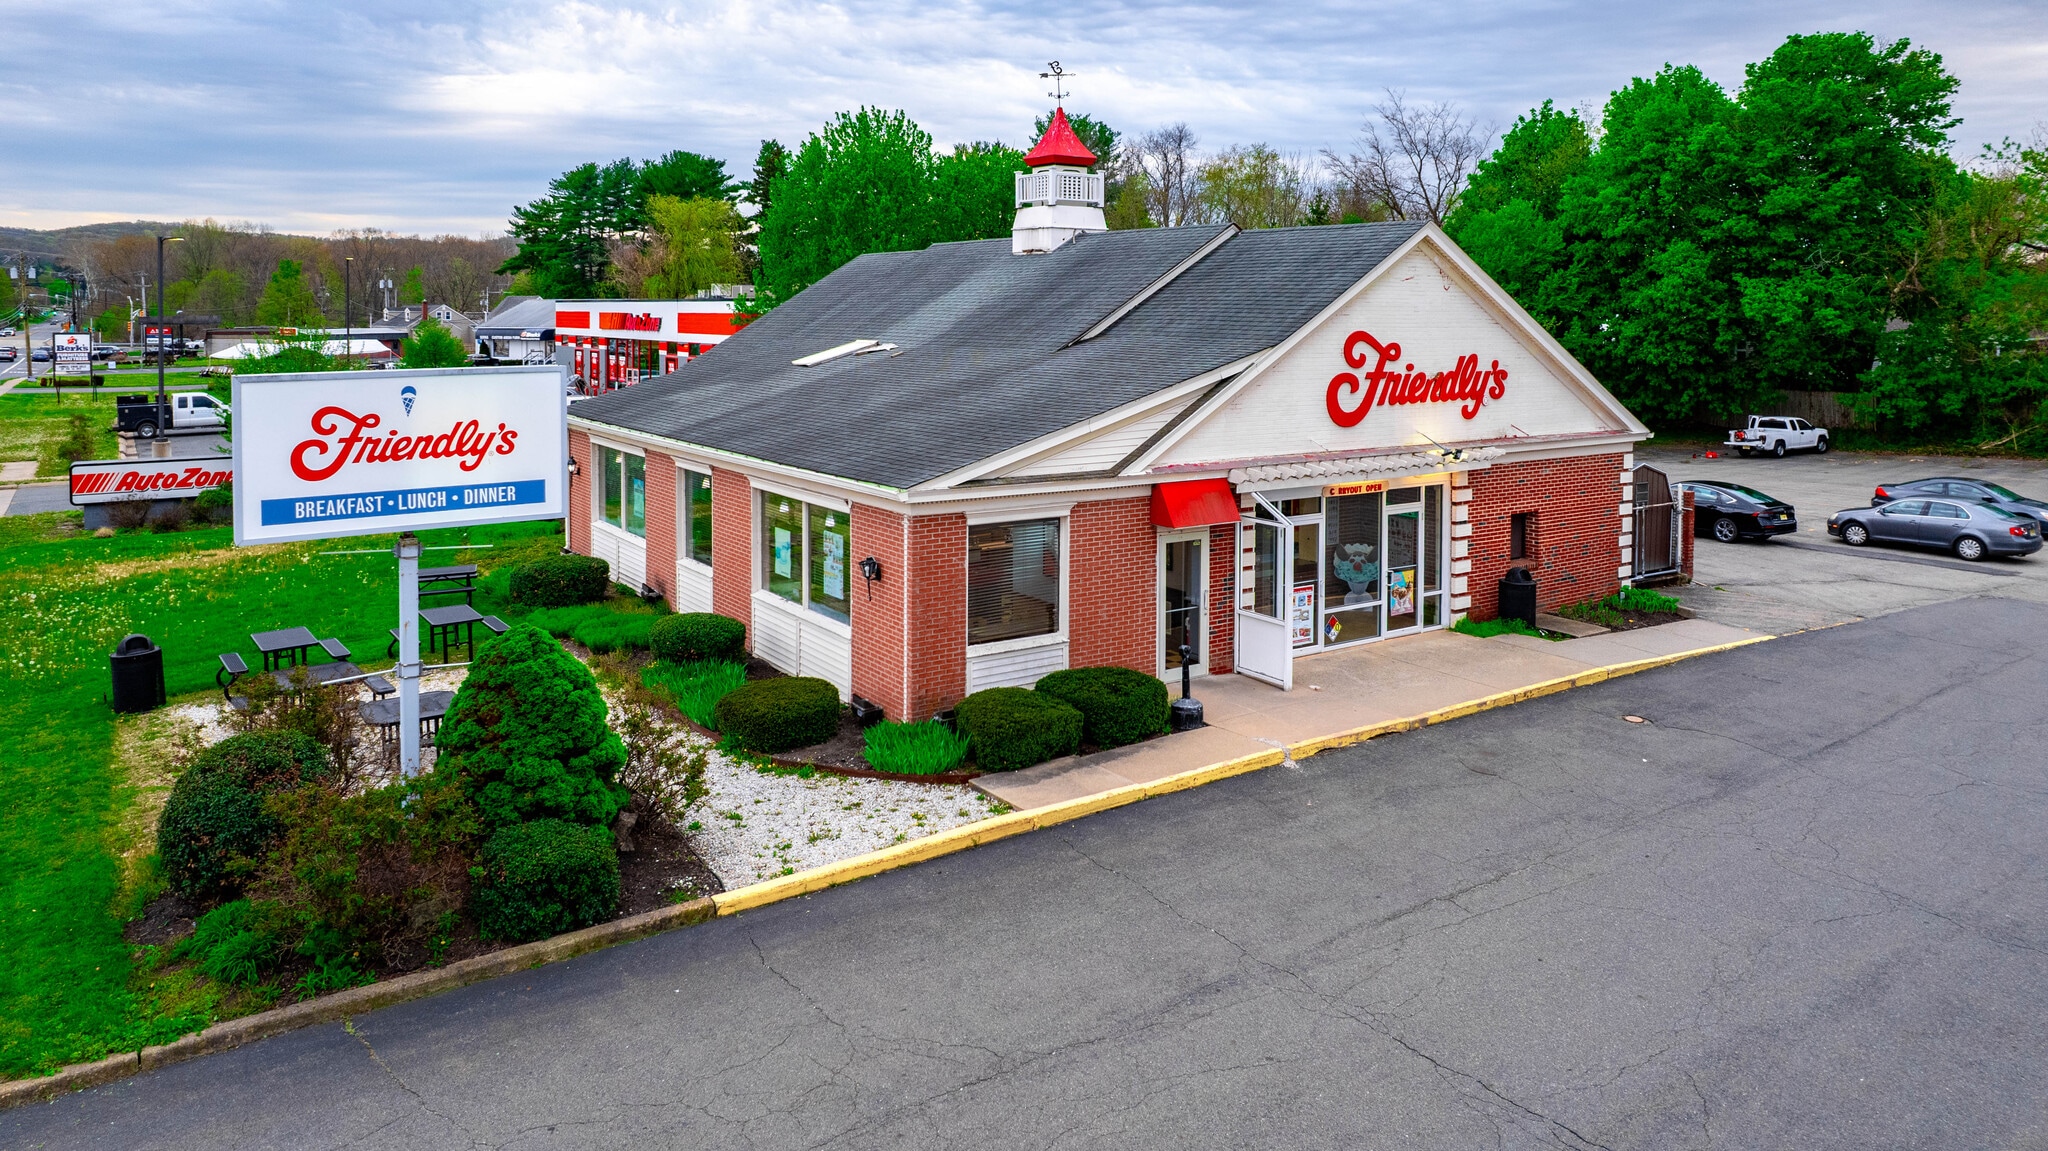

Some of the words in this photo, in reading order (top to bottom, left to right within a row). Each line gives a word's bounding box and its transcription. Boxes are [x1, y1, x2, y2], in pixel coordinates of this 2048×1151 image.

[1327, 331, 1508, 427] Friendly's
[290, 406, 518, 482] Friendly's
[295, 496, 384, 519] BREAKFAST
[398, 491, 446, 510] LUNCH
[464, 486, 516, 505] DINNER
[1366, 484, 1382, 492] OPEN
